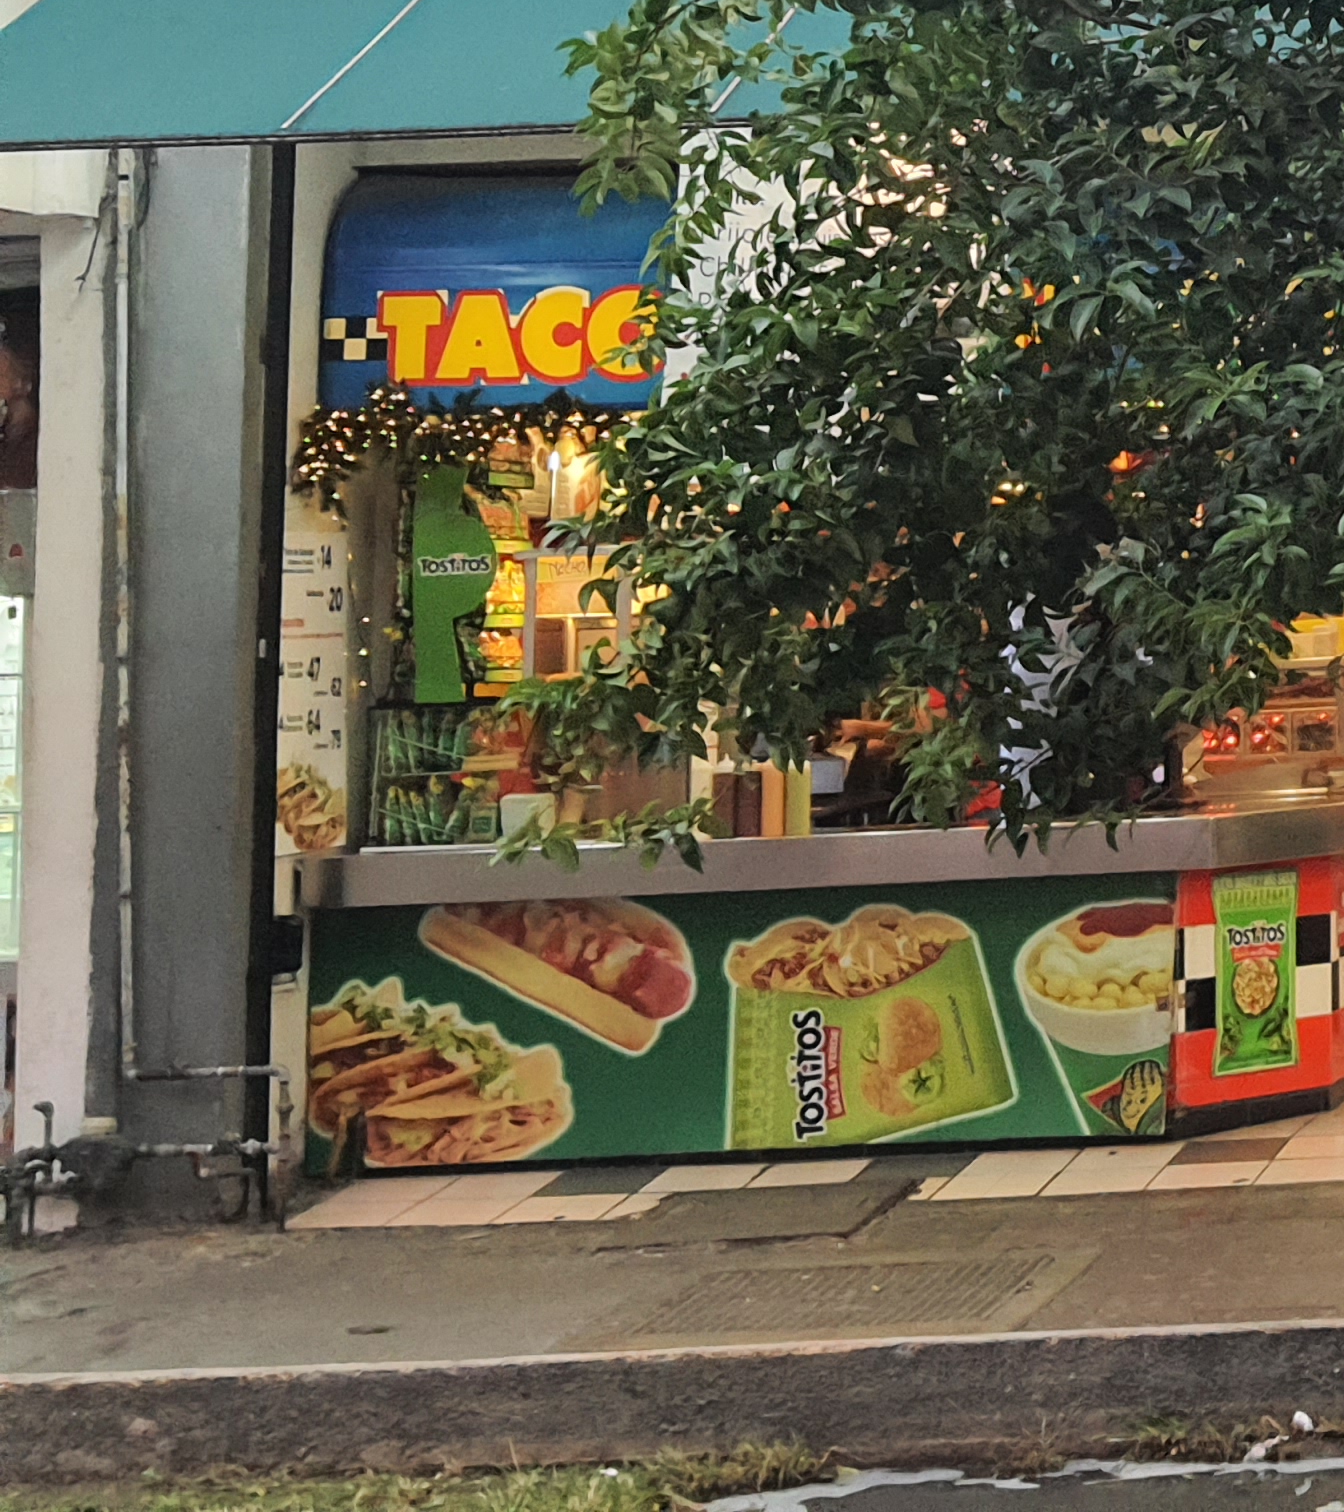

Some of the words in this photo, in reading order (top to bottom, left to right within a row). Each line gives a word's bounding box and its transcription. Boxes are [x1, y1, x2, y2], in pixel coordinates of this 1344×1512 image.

[420, 557, 491, 575] TOSTITOS
[1227, 922, 1285, 947] TOSTITOS
[791, 1009, 825, 1140] TOSTITOS
